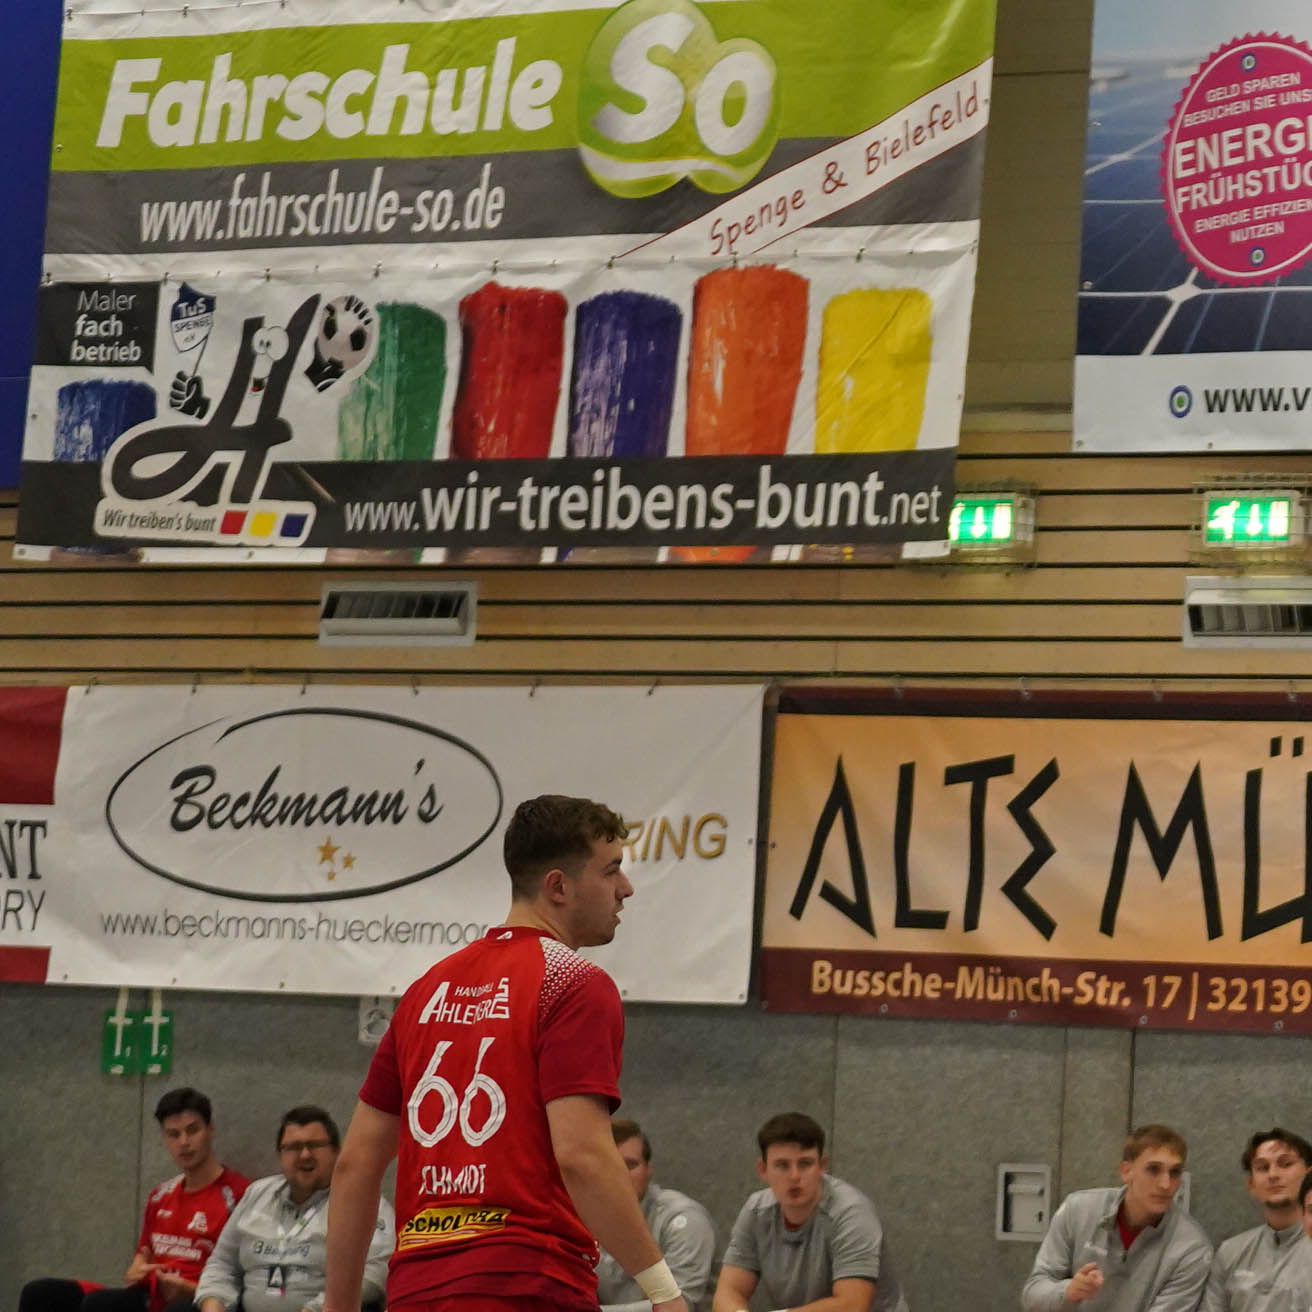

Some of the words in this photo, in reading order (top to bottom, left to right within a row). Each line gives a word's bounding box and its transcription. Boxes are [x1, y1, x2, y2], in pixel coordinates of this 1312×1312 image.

[96, 37, 564, 149] Fahrschule
[592, 12, 771, 156] So
[1205, 84, 1241, 102] GELD
[1243, 72, 1301, 93] SPAREN
[1183, 100, 1250, 128] BESUCHEN
[1253, 94, 1278, 110] SIE
[710, 188, 806, 256] Spenge
[822, 161, 848, 194] &
[865, 82, 979, 176] Bielefeld
[140, 162, 506, 243] www.fahrschule-so.de
[1195, 208, 1251, 233] ENERGIE
[1231, 221, 1285, 243] NUTZEN
[75, 314, 123, 337] fach
[77, 290, 137, 311] Maler
[70, 339, 142, 361] betrieb
[103, 509, 128, 527] Wir
[185, 511, 217, 532] bunt
[344, 464, 942, 534] www.wir-treibens-bunt.net
[169, 757, 443, 832] Beckmann's
[789, 754, 1058, 942] ALTE
[811, 960, 1132, 1007] Bussche-Münch-Str.
[1142, 974, 1183, 1009] 17
[1207, 977, 1310, 1013] 32139
[407, 1036, 507, 1148] 66
